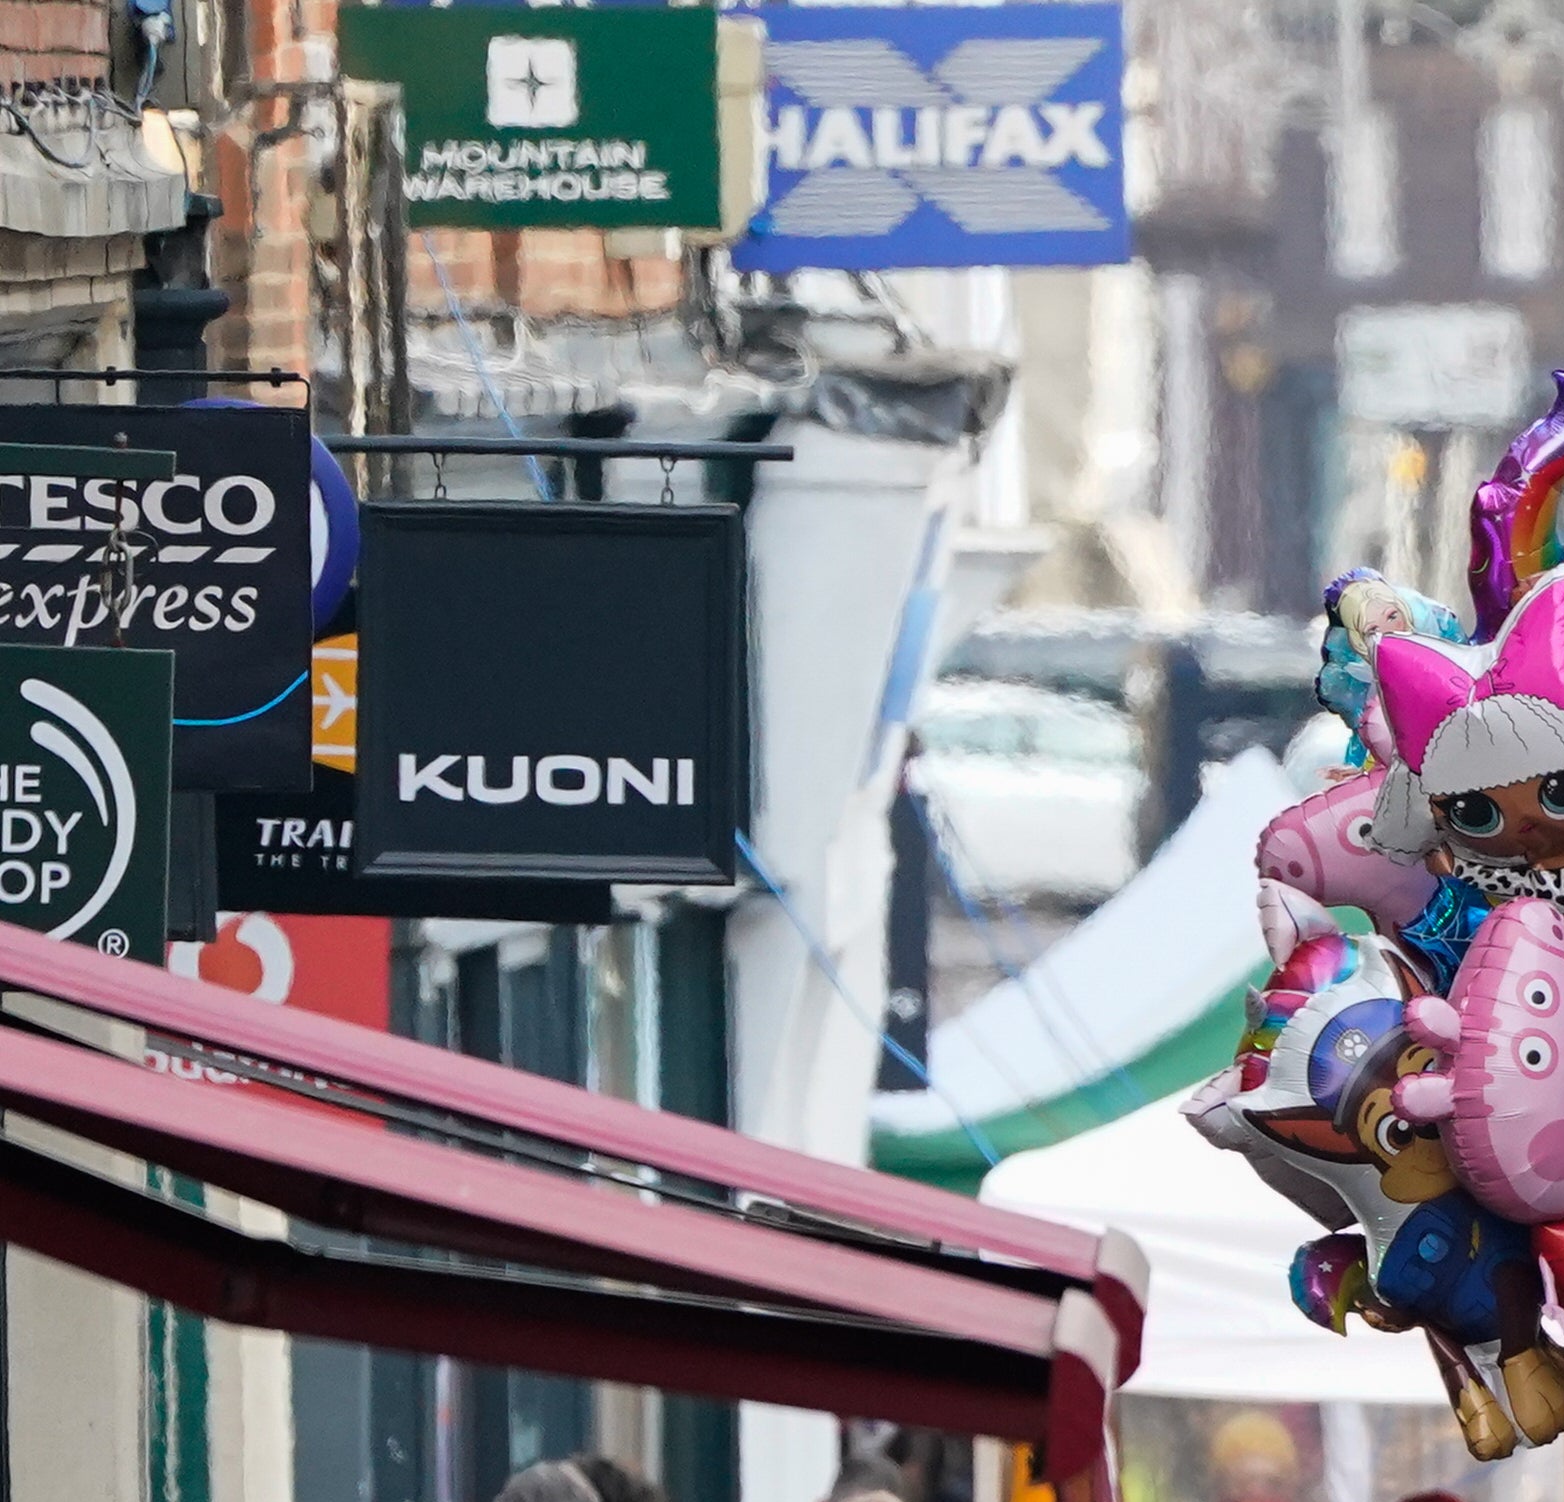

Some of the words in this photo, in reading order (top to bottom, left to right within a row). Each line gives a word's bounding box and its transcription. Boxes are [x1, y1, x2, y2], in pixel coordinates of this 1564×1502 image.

[420, 138, 647, 171] MOUNTAIN
[762, 103, 1113, 169] HALIFAX
[403, 169, 671, 202] WAREHOUSE
[399, 753, 695, 806] KUONI
[2, 808, 84, 856] DY
[256, 817, 354, 849] TRAI
[0, 859, 72, 905] OP
[320, 854, 348, 871] TR
